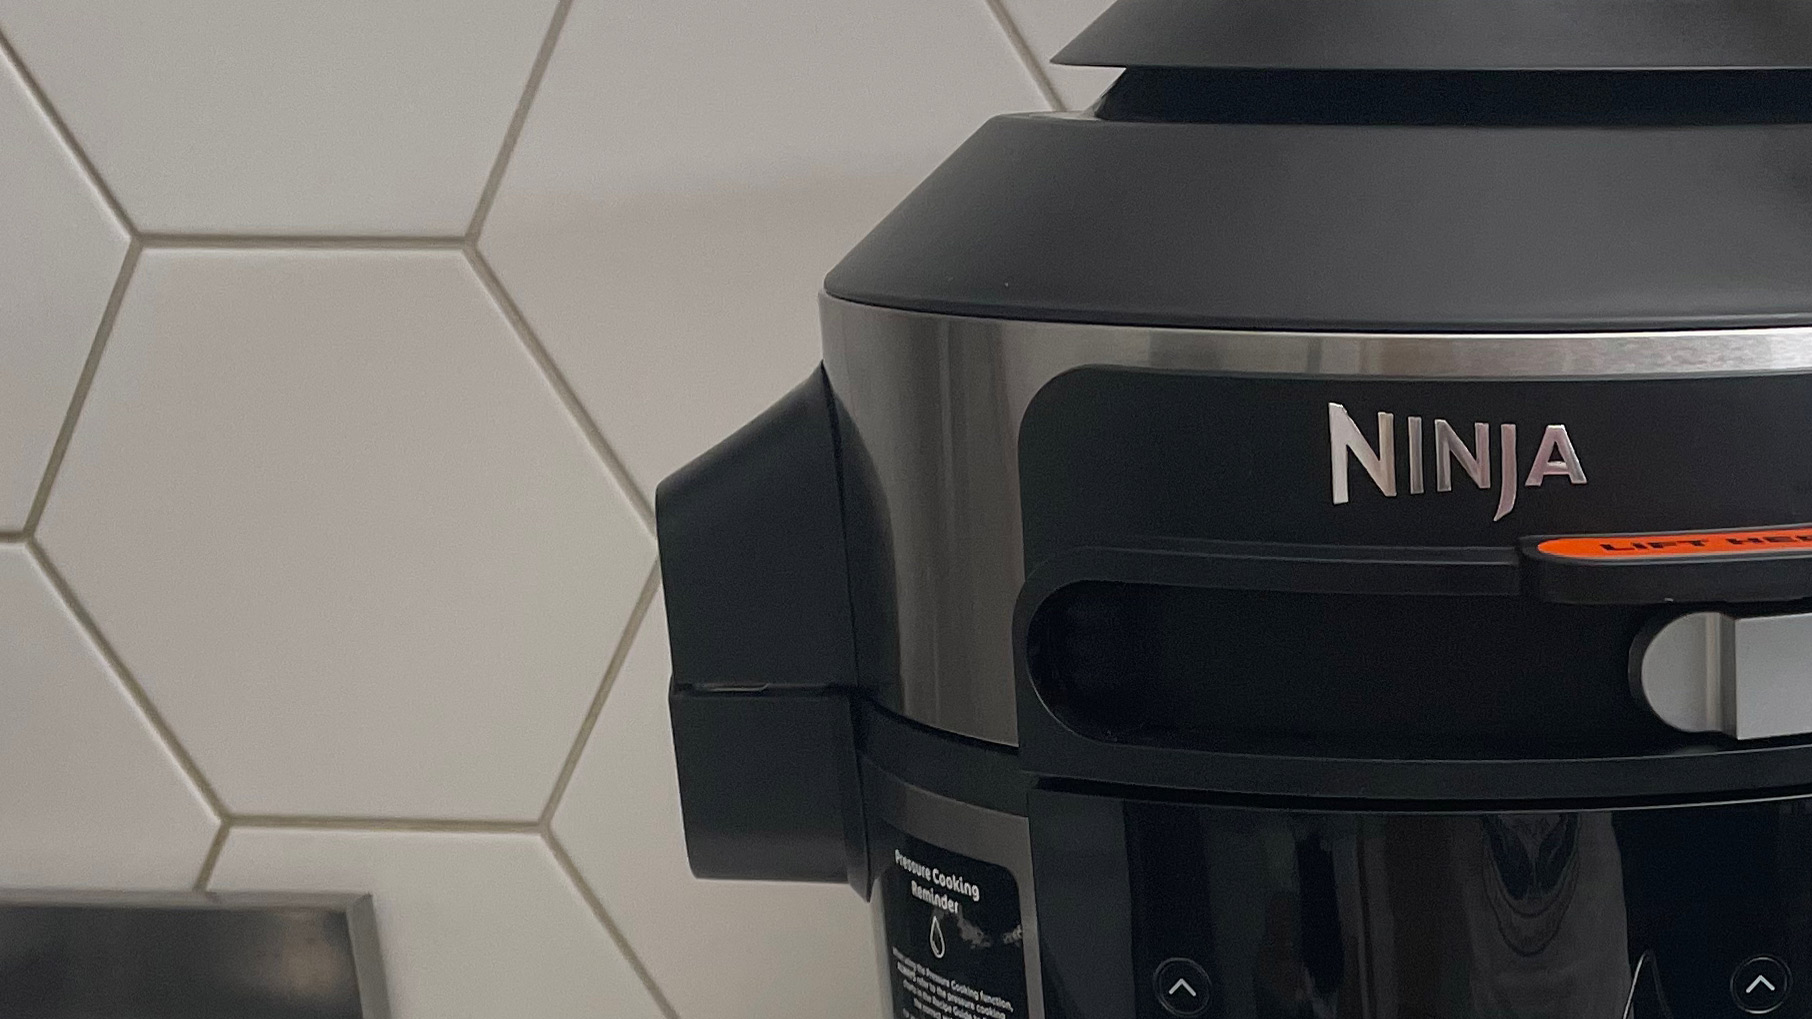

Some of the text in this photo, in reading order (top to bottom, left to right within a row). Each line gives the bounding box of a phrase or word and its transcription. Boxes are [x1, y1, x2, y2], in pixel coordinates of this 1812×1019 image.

[1328, 402, 1587, 522] NINJA
[1600, 540, 1709, 552] LIFT
[895, 849, 980, 902] Pressure Cooking
[911, 880, 959, 915] Reminder
[947, 993, 975, 1010] pressure
[950, 979, 978, 1000] Cooking
[979, 990, 1013, 1012] function,
